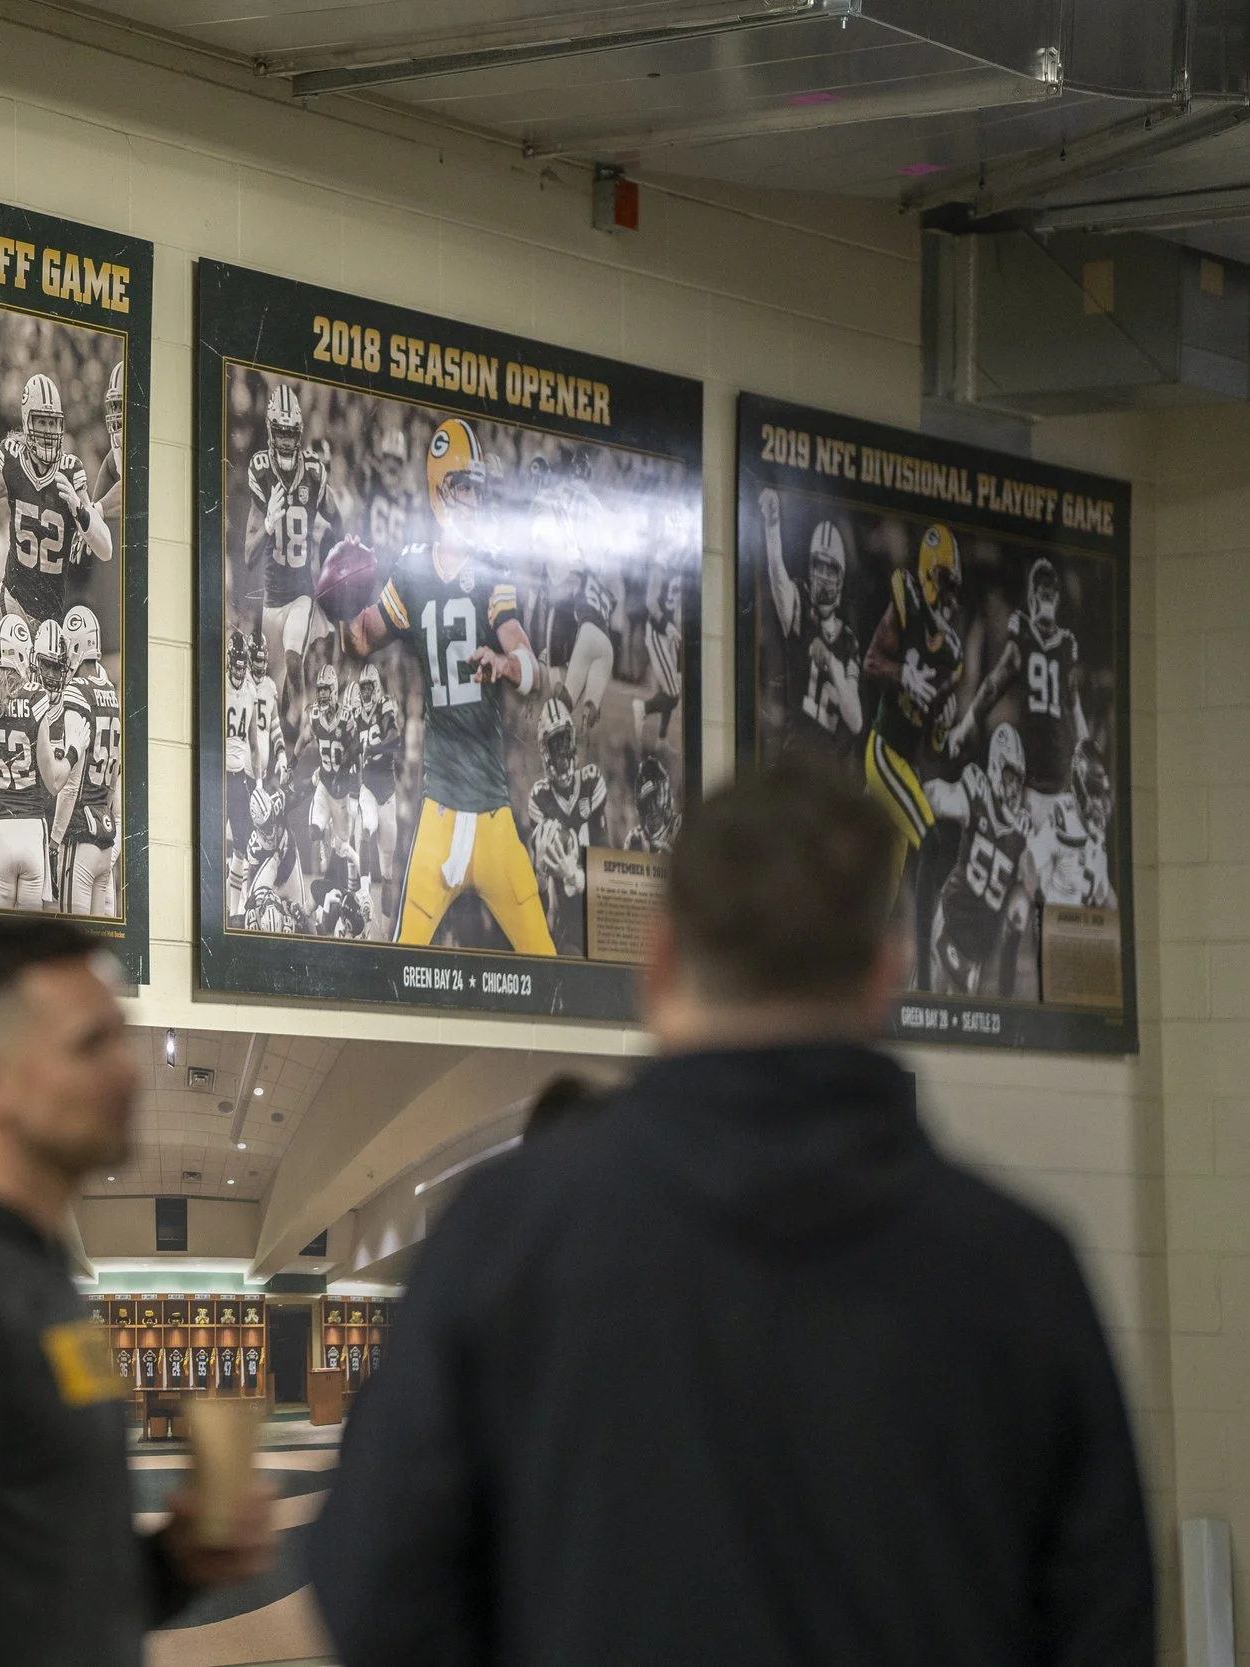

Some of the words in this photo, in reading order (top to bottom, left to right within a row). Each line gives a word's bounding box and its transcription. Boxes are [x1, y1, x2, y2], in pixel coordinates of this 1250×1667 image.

[42, 248, 130, 314] GAME
[313, 315, 381, 373] 2018
[390, 335, 499, 401] SEASON
[506, 361, 610, 426] OPENER
[430, 430, 451, 458] G
[761, 423, 811, 470] 2019
[815, 435, 857, 481] NFC
[861, 446, 973, 503] DIVISIONAL
[976, 472, 1058, 522] PLAYOFF
[1061, 492, 1114, 536] GAME
[15, 499, 65, 575] 52
[271, 506, 308, 567] 18
[421, 597, 482, 707] 12
[1028, 652, 1062, 719] 91
[102, 813, 112, 833] G
[603, 860, 644, 877] SEPTEMBER
[403, 966, 432, 988] GREEN
[434, 968, 451, 990] BAY
[452, 970, 464, 991] 24
[482, 972, 519, 995] CHICAGO
[520, 974, 532, 996] 23
